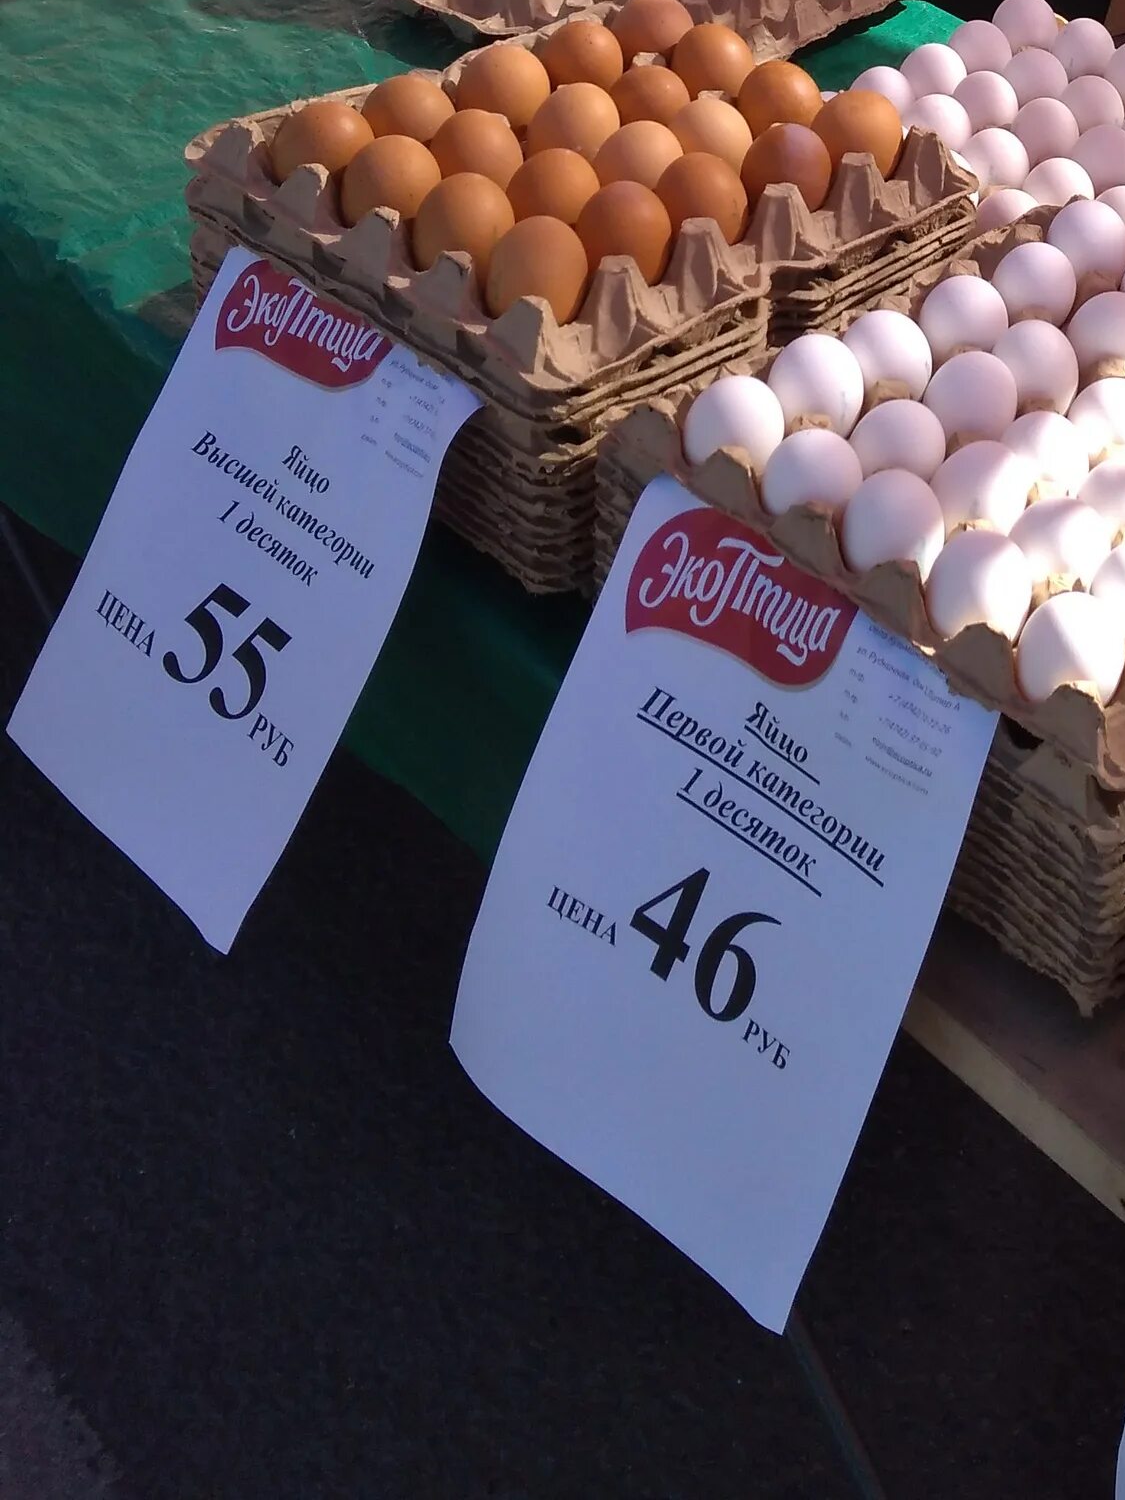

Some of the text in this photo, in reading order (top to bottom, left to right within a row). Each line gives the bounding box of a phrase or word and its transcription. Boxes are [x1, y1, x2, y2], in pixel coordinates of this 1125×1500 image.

[228, 274, 382, 372] ЭкоПтица
[190, 430, 281, 513] Высшей
[275, 498, 376, 580] категории
[282, 444, 331, 494] Яйцо
[217, 500, 319, 587] 1 десяток
[639, 532, 840, 666] ЭкоПтица
[95, 582, 295, 770] ЦЕНА 55 РУБ
[744, 702, 809, 765] Яйцо
[638, 687, 886, 873] Первой категории
[682, 767, 818, 877] 1 десяток
[546, 867, 791, 1069] ЦЕНА 46 РУБ
